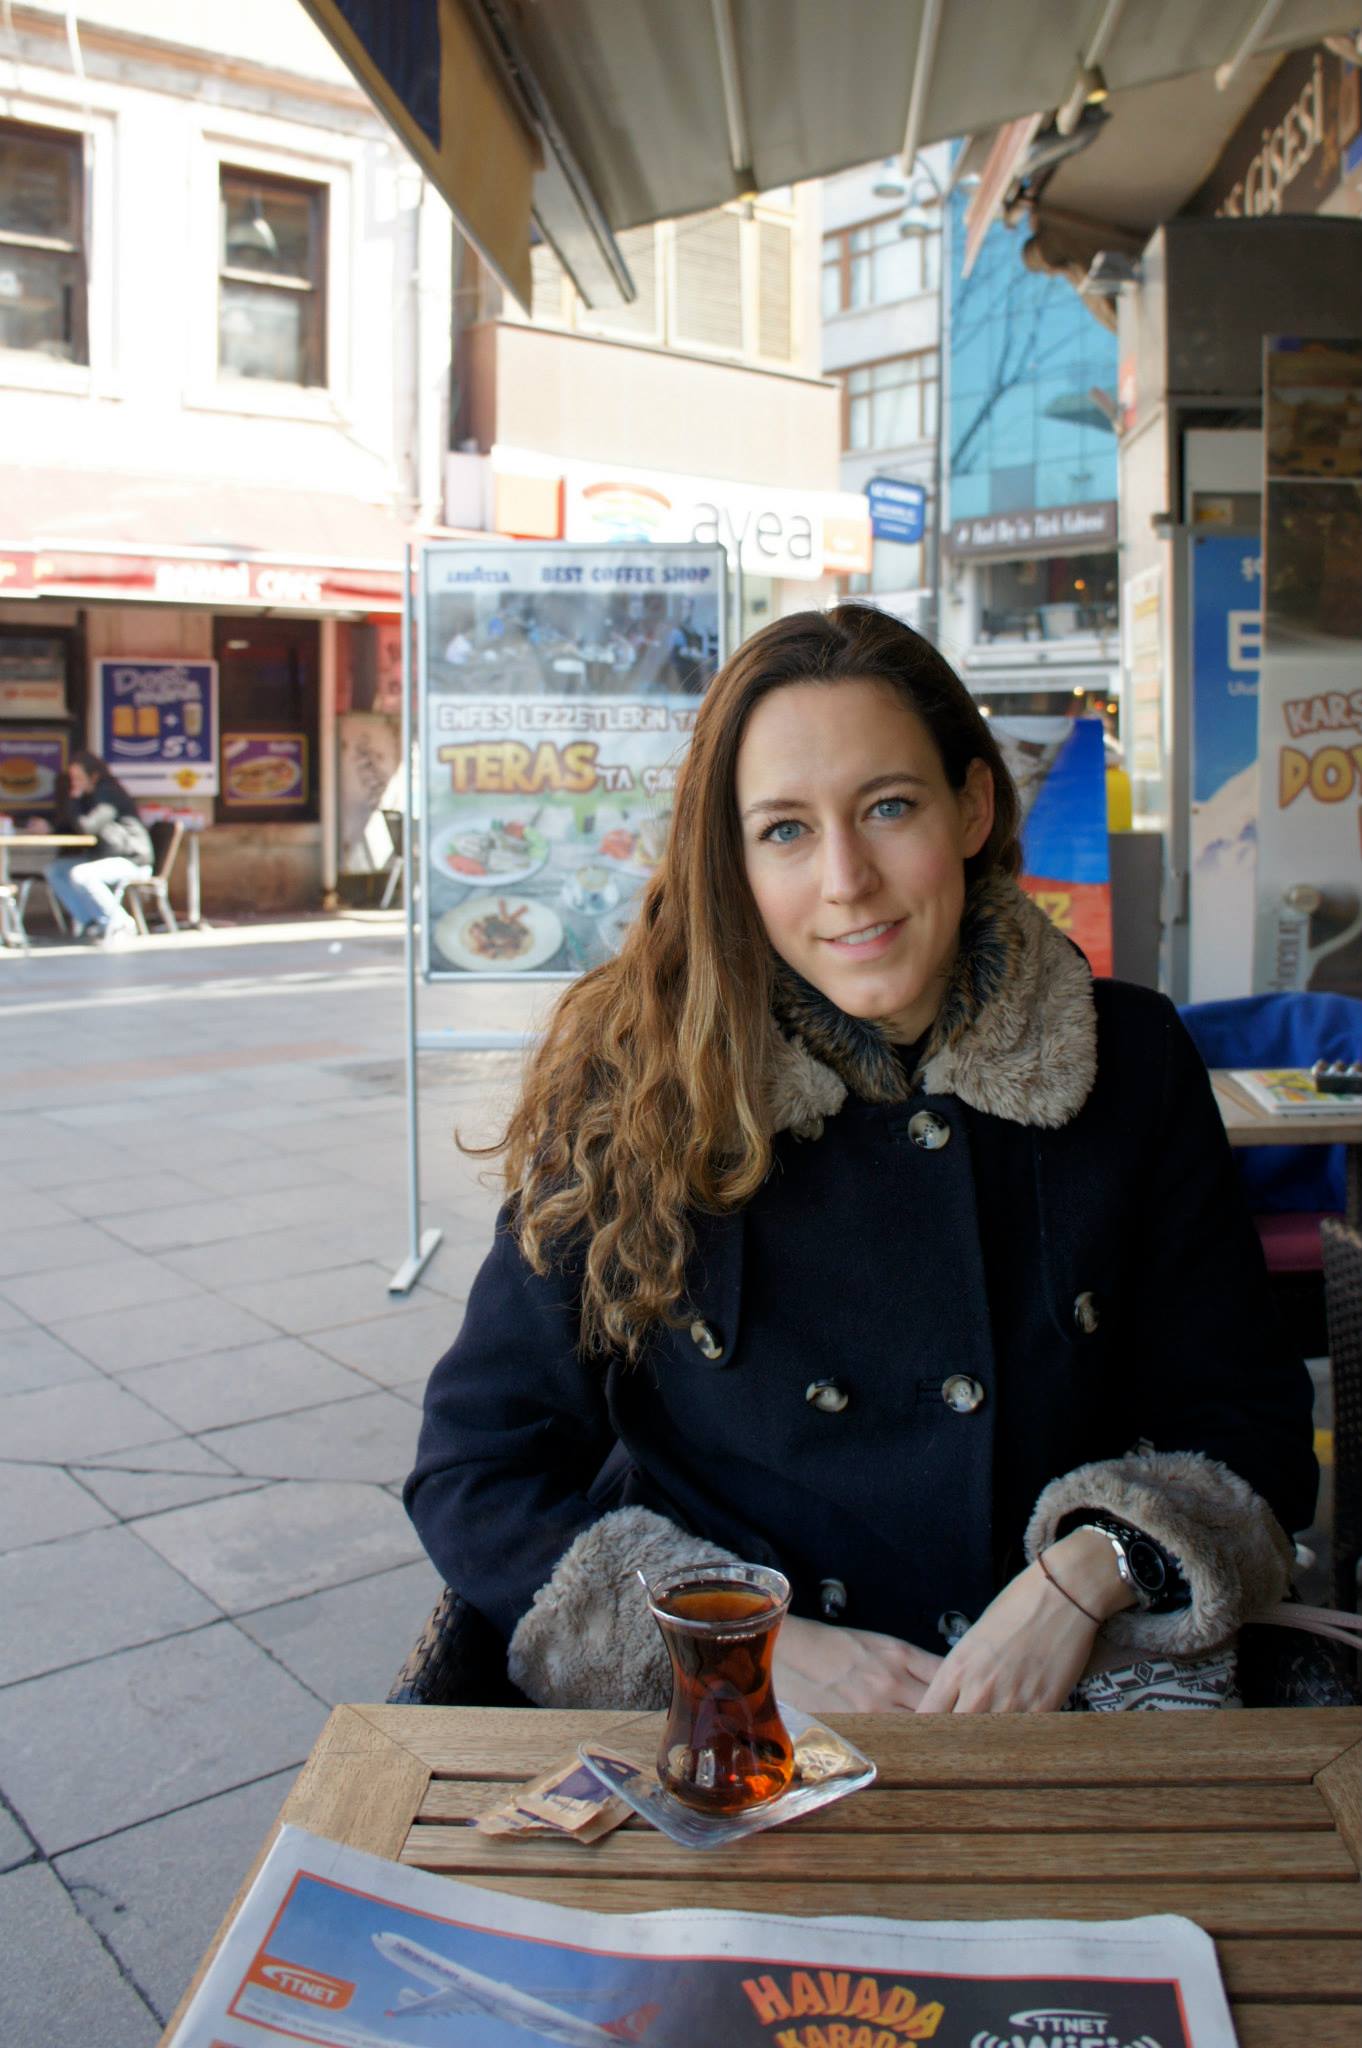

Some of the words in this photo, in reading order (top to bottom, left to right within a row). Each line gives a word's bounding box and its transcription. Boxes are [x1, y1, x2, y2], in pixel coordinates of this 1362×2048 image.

[541, 566, 583, 583] BEST
[591, 566, 656, 583] COFFEE
[662, 566, 711, 583] SHOP
[438, 703, 514, 731] ENFES
[276, 1974, 339, 2004] TTNET
[741, 1971, 945, 2040] HAVADA
[776, 2023, 917, 2048] KARAD
[1033, 2016, 1109, 2035] TTNET
